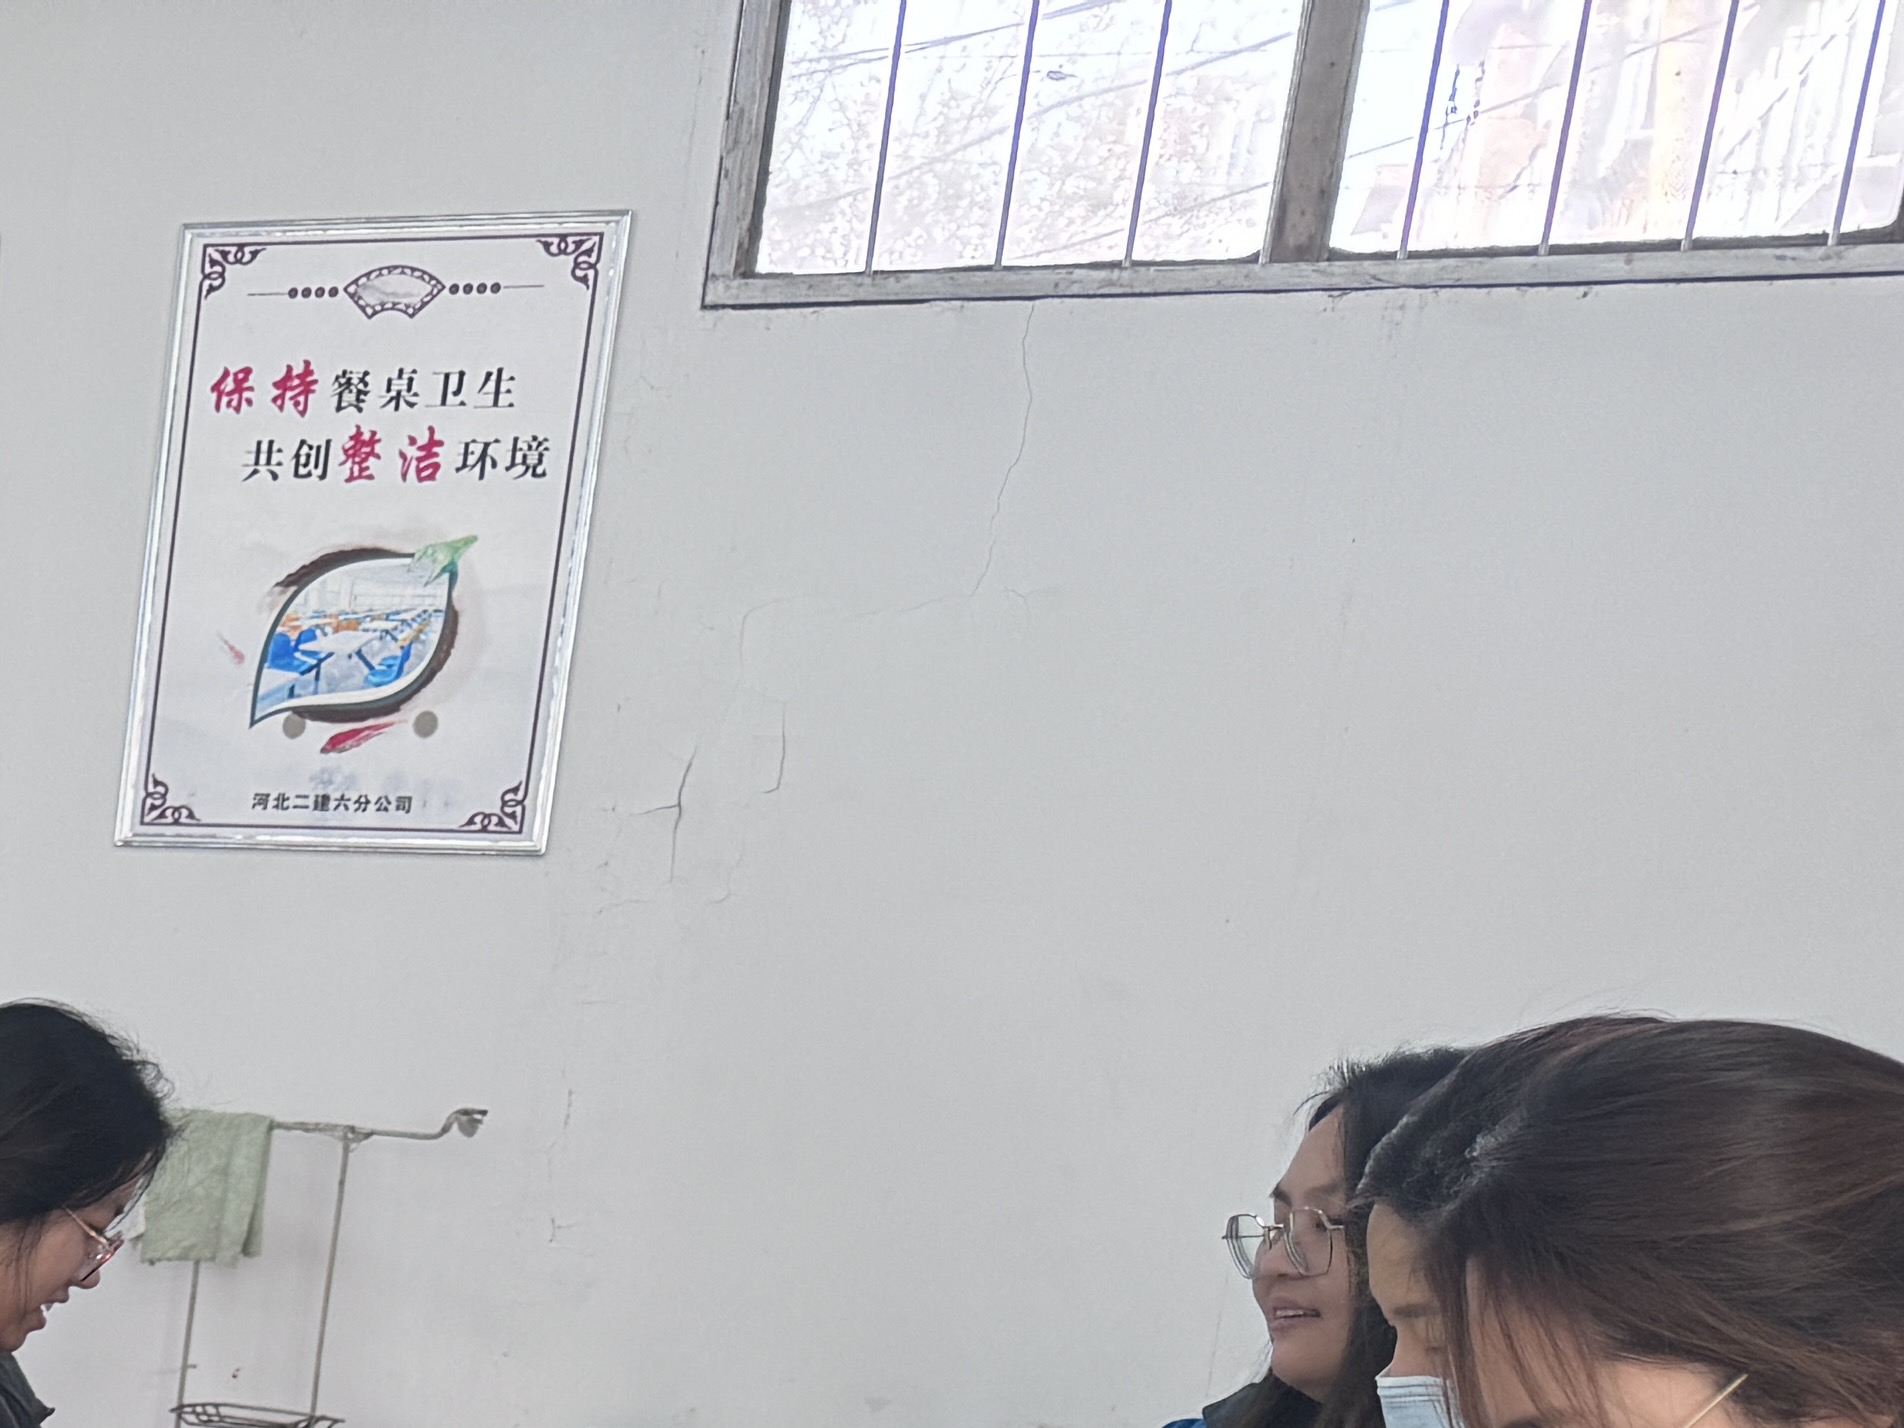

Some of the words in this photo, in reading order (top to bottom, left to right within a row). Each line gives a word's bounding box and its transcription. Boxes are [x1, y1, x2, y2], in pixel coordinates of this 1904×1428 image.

[210, 359, 517, 418] 保持餐桌卫生
[241, 425, 552, 484] 共创整洁环境
[251, 792, 414, 815] 河北二建六分公司
